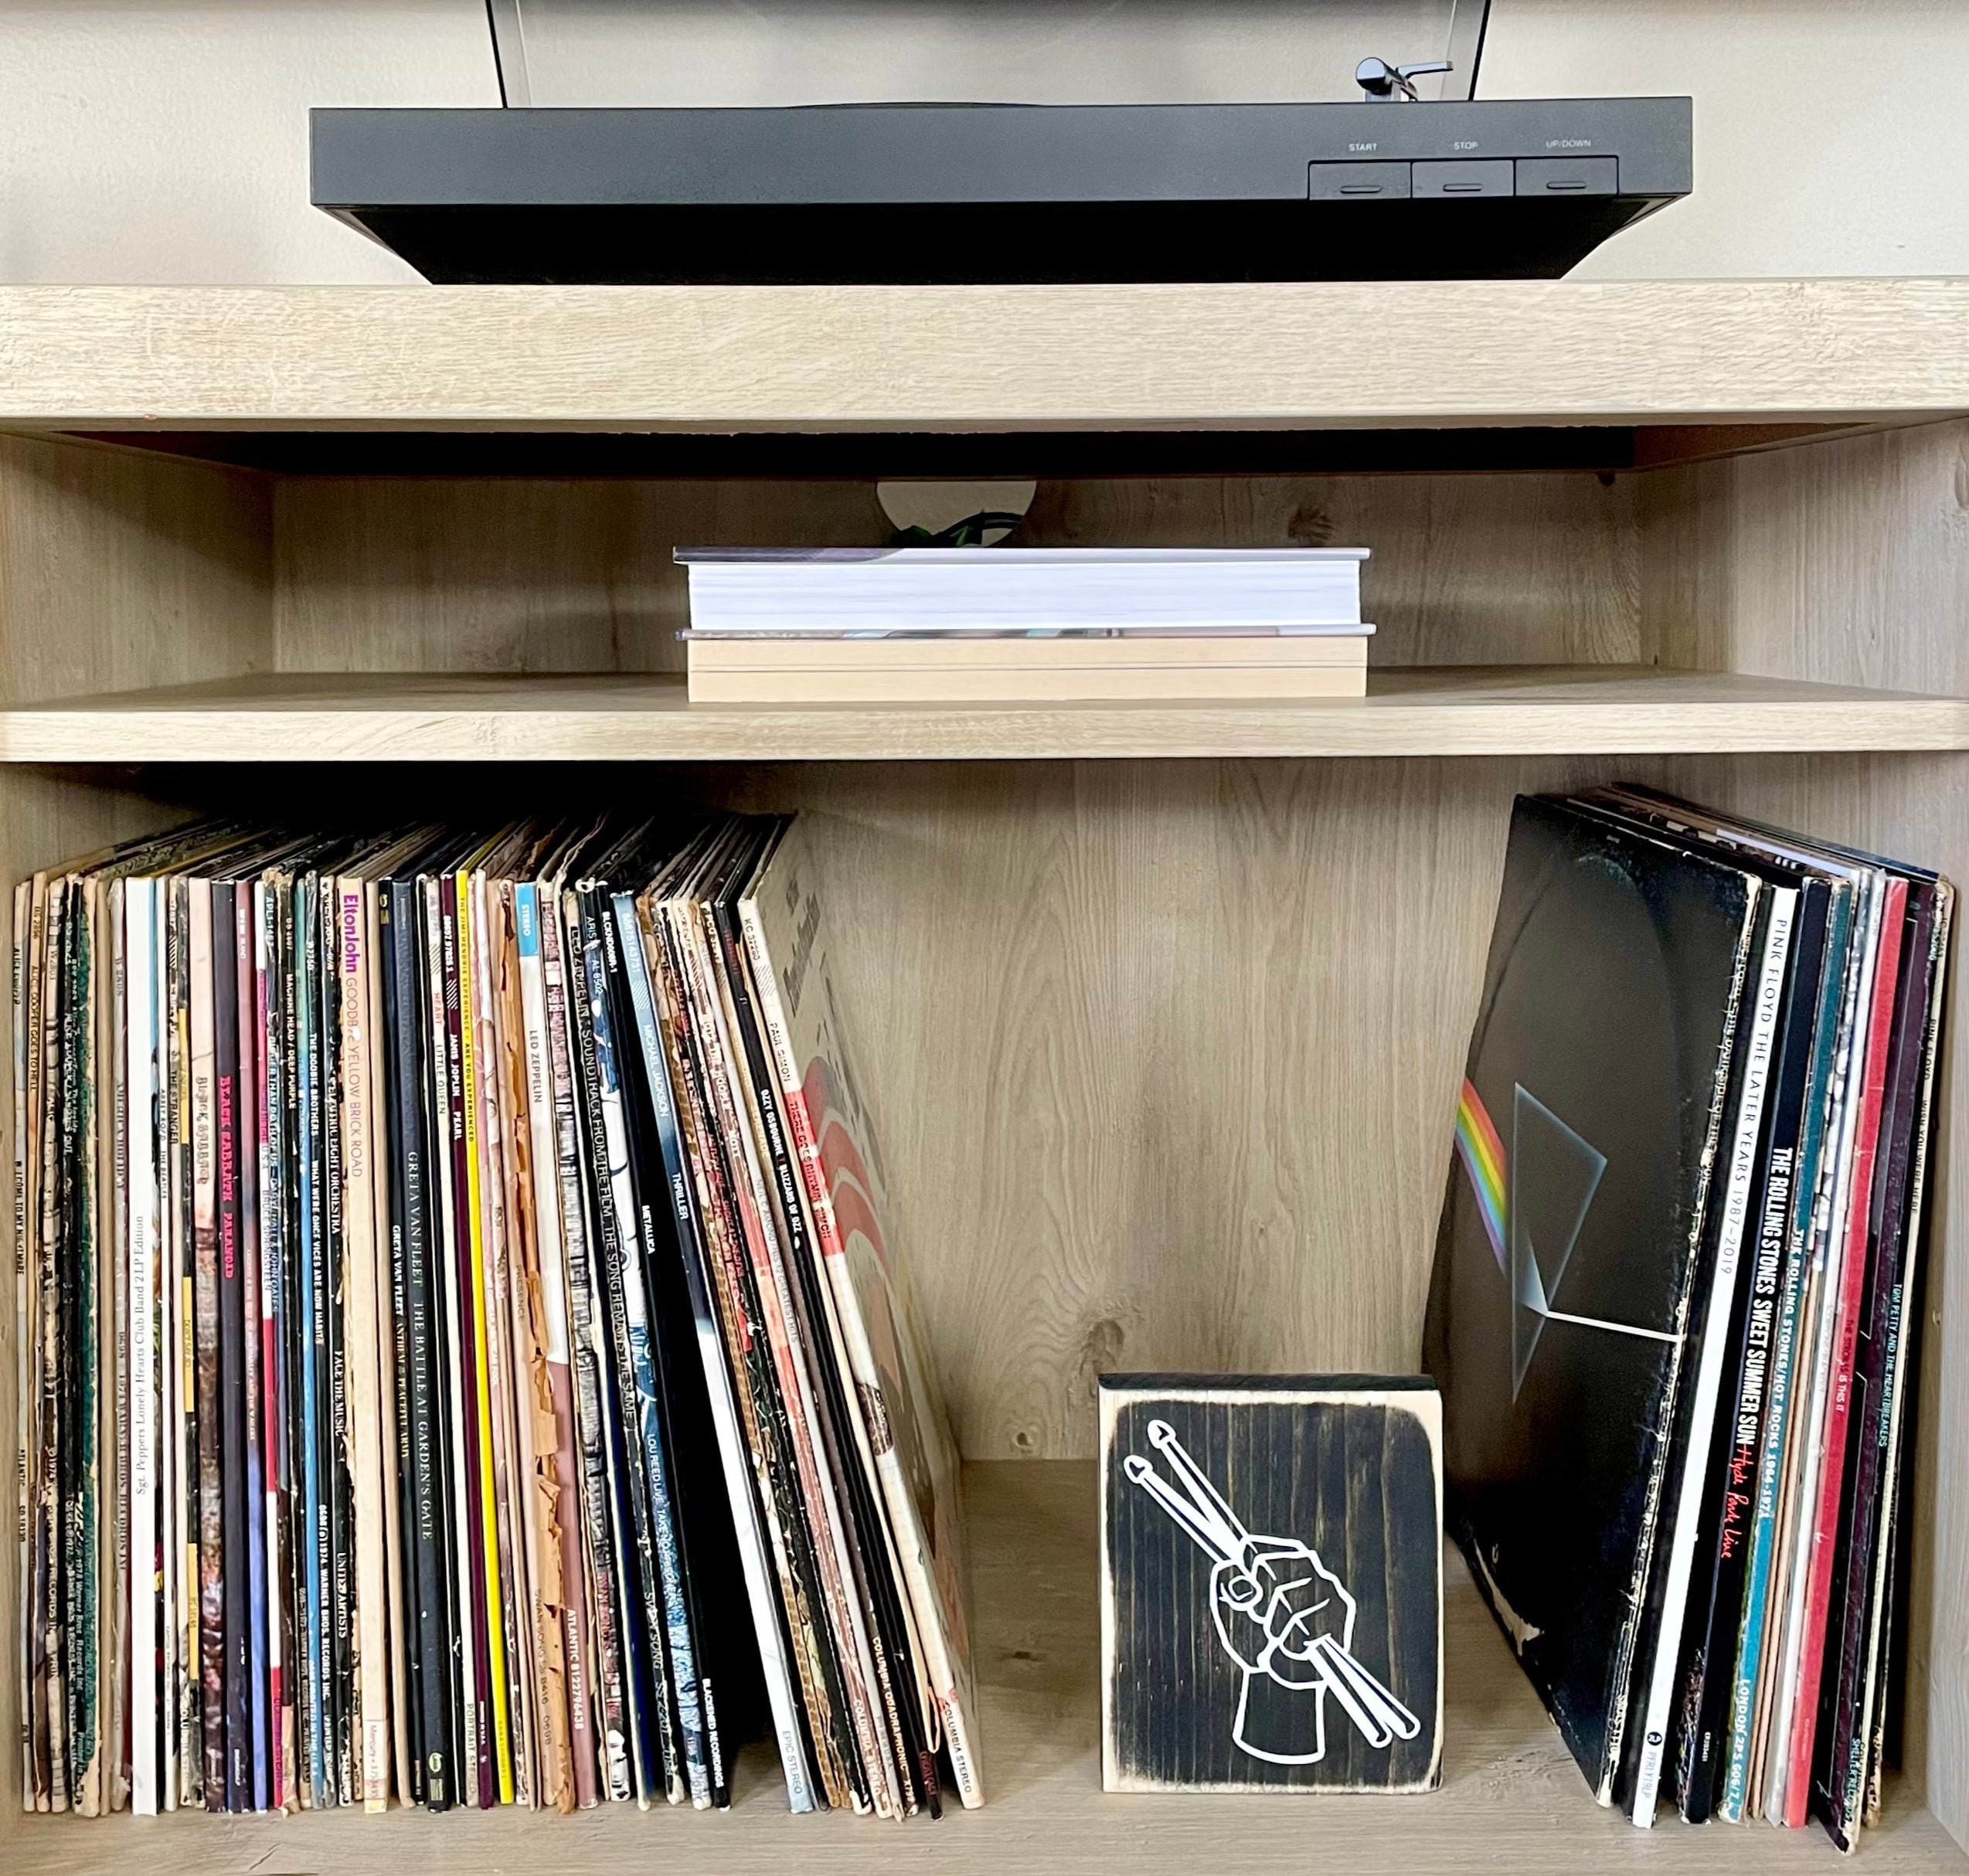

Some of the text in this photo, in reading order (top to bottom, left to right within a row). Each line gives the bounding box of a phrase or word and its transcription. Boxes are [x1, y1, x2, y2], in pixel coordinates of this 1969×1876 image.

[1348, 142, 1377, 151] START
[1454, 141, 1478, 150] STOP
[1546, 139, 1592, 148] UP/DOWN
[522, 904, 531, 936] STEREO
[1770, 919, 1787, 960] PINK
[573, 958, 587, 1018] ZEPPELIN
[1760, 968, 1779, 1022] FLOYD
[31, 1056, 38, 1069] TO
[287, 1050, 296, 1073] DEEP
[449, 1034, 461, 1097] JANIS JOPLIN
[461, 978, 470, 1031] EXPERIENCE
[466, 1082, 474, 1143] EXPERIENCED
[529, 1030, 542, 1103] LED ZEPPELIN
[770, 1023, 791, 1082] PAUL SIMON
[1753, 1032, 1769, 1062] THE
[1924, 1018, 1937, 1080] PINK FLOYD
[349, 1046, 360, 1098] YELLOW
[436, 1045, 446, 1114] LITTLE QUEEN
[581, 1029, 601, 1117] SOUNDTRACK
[642, 1025, 669, 1117] MICHAEL JACKSON
[287, 1076, 297, 1110] PURPLE
[1743, 1071, 1763, 1122] LATER
[1919, 1099, 1928, 1126] WISH
[170, 1092, 179, 1144] STRANGER
[350, 1103, 362, 1136] BRICK
[453, 1111, 462, 1140] PEARL
[760, 1089, 784, 1156] OZZY OSBOURNE
[790, 1101, 811, 1162] THERE GOES
[351, 1140, 362, 1177] ROAD
[593, 1120, 604, 1158] FROM
[1734, 1131, 1753, 1182] YEARS
[1916, 1129, 1925, 1150] YOU
[220, 1076, 233, 1278] BLACK SABBATH PARANOID
[311, 1161, 319, 1186] WHAT
[597, 1160, 607, 1184] THE
[1770, 1147, 1794, 1174] THE
[1913, 1154, 1923, 1184] WERE
[330, 1171, 340, 1234] ORCHESTRA
[598, 1187, 611, 1217] FILM
[672, 1172, 689, 1220] THRILLER
[779, 1164, 802, 1233] BLIZZARD OF OZZ
[1762, 1177, 1790, 1236] ROLLING
[134, 1216, 145, 1255] Edition
[604, 1227, 615, 1250] THE
[641, 1205, 656, 1254] METALLICA
[1791, 1229, 1805, 1255] THE
[134, 1258, 144, 1275] LP
[312, 1242, 321, 1267] VICES
[608, 1253, 621, 1290] SONG
[1755, 1239, 1780, 1294] STONES
[135, 1286, 145, 1314] Band
[393, 1225, 406, 1363] GRETA VAN FLEET ANTHEM
[515, 1264, 525, 1322] PRESENCE
[1784, 1259, 1801, 1315] ROLLING
[1892, 1283, 1903, 1303] TOM
[135, 1317, 145, 1344] Club
[1748, 1299, 1774, 1348] SWEET
[1889, 1304, 1899, 1331] PETTY
[408, 1152, 433, 1540] GRETA VAN FLEET THE BATTLE AT GARDEN'S GATE
[1885, 1355, 1896, 1371] THE
[1886, 1333, 1897, 1352] AND
[135, 1348, 145, 1383] Hearts
[619, 1355, 631, 1379] THE
[1739, 1349, 1767, 1412] SUMMER
[136, 1388, 148, 1426] Lonely
[334, 1351, 344, 1436] FACE THE MUSIC
[622, 1382, 634, 1420] SAME
[1836, 1385, 1847, 1405] THIS
[1879, 1374, 1895, 1447] HEARTBREAKERS
[1736, 1415, 1756, 1445] SUN
[1768, 1405, 1783, 1449] ROCKS
[136, 1429, 148, 1470] Peppers
[647, 1434, 663, 1504] LOU REED LIVE
[1728, 1444, 1754, 1485] Hyde
[1723, 1492, 1750, 1523] Park
[321, 1639, 330, 1680] RECORDS
[567, 1609, 584, 1729] ATLANTIC 8122796438
[872, 1637, 889, 1689] COLUMBIA
[884, 1691, 907, 1771] QUADRAPHONIC
[1733, 1678, 1751, 1760] LONDON 2PS
[466, 1704, 474, 1752] PORTRAIT
[687, 1736, 695, 1755] 1198
[702, 1678, 724, 1788] BLACKENED RECORDINGS
[782, 1731, 803, 1794] EPIC STEREO
[955, 1755, 972, 1793] STEREO
[1848, 1738, 1861, 1774] SHELTER
